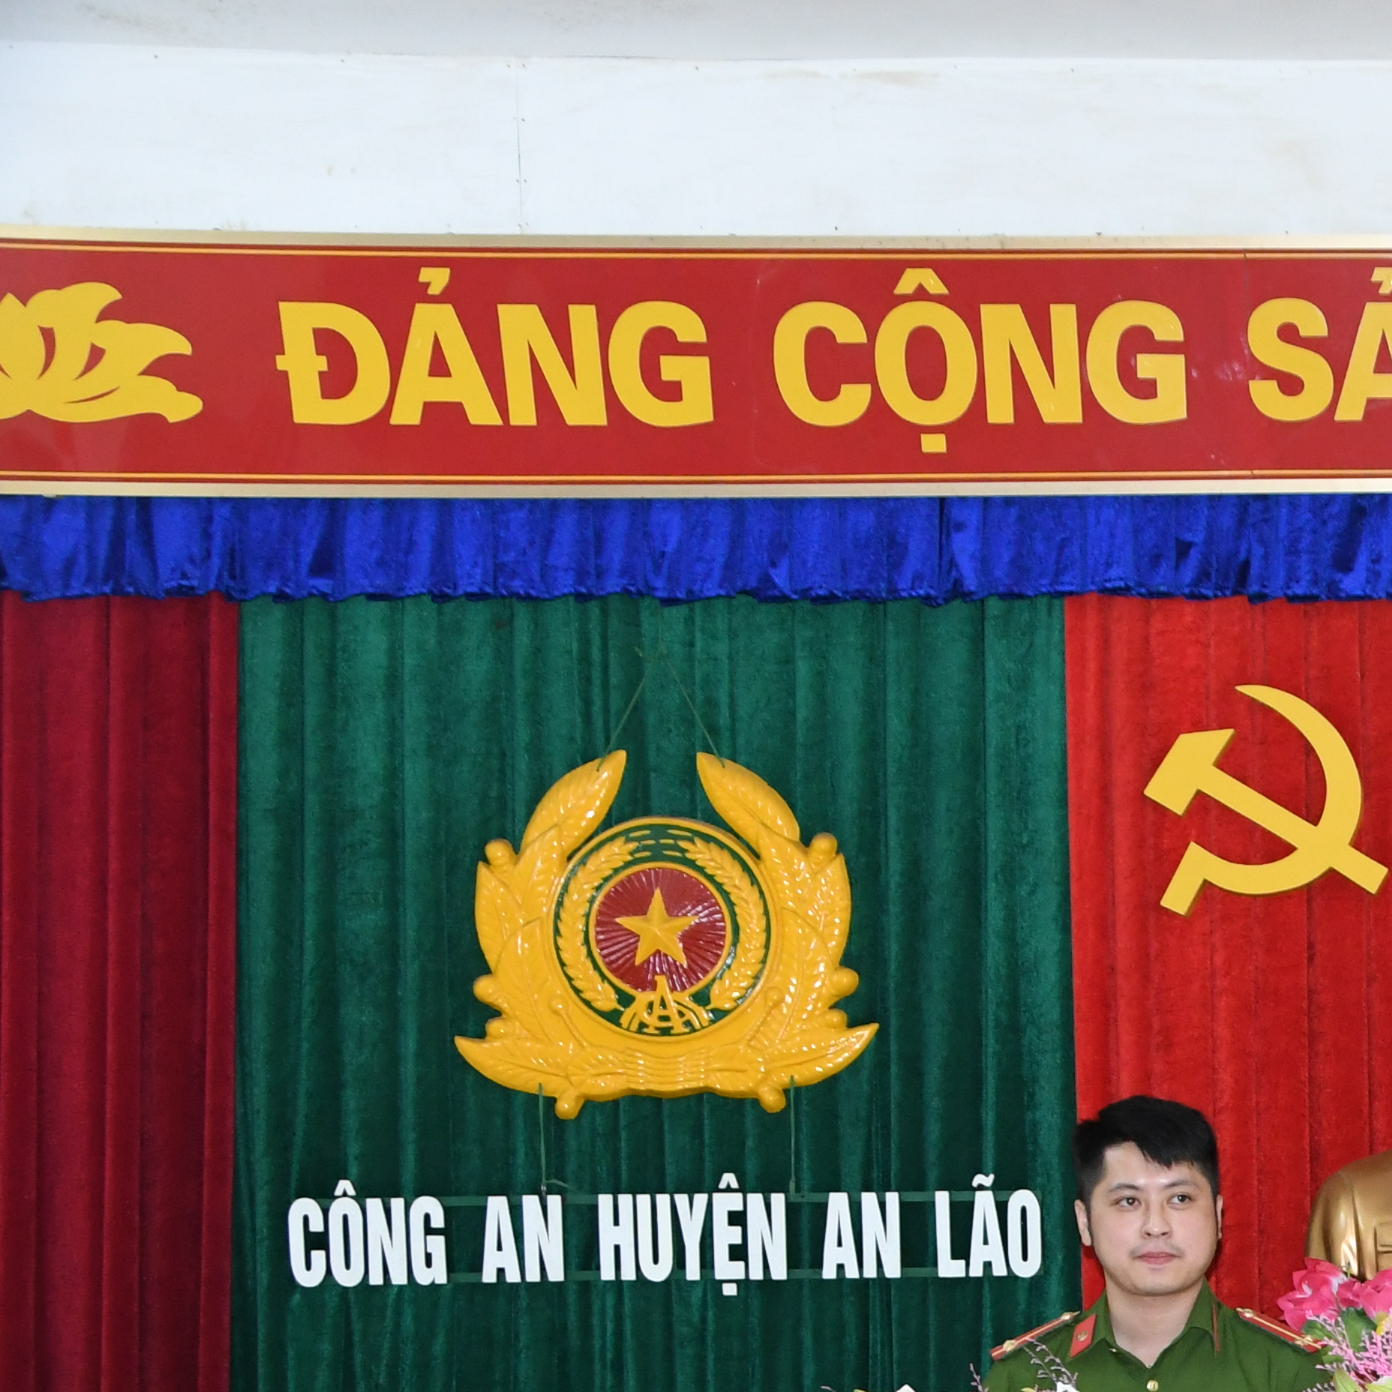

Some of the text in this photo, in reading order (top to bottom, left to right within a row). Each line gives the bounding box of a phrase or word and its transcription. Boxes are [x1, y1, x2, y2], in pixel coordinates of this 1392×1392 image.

[275, 267, 715, 427] ĐẢNG
[772, 267, 1188, 454] CỘNG
[287, 1172, 1043, 1297] CÔNG AN HUYỆN AN LÃO
